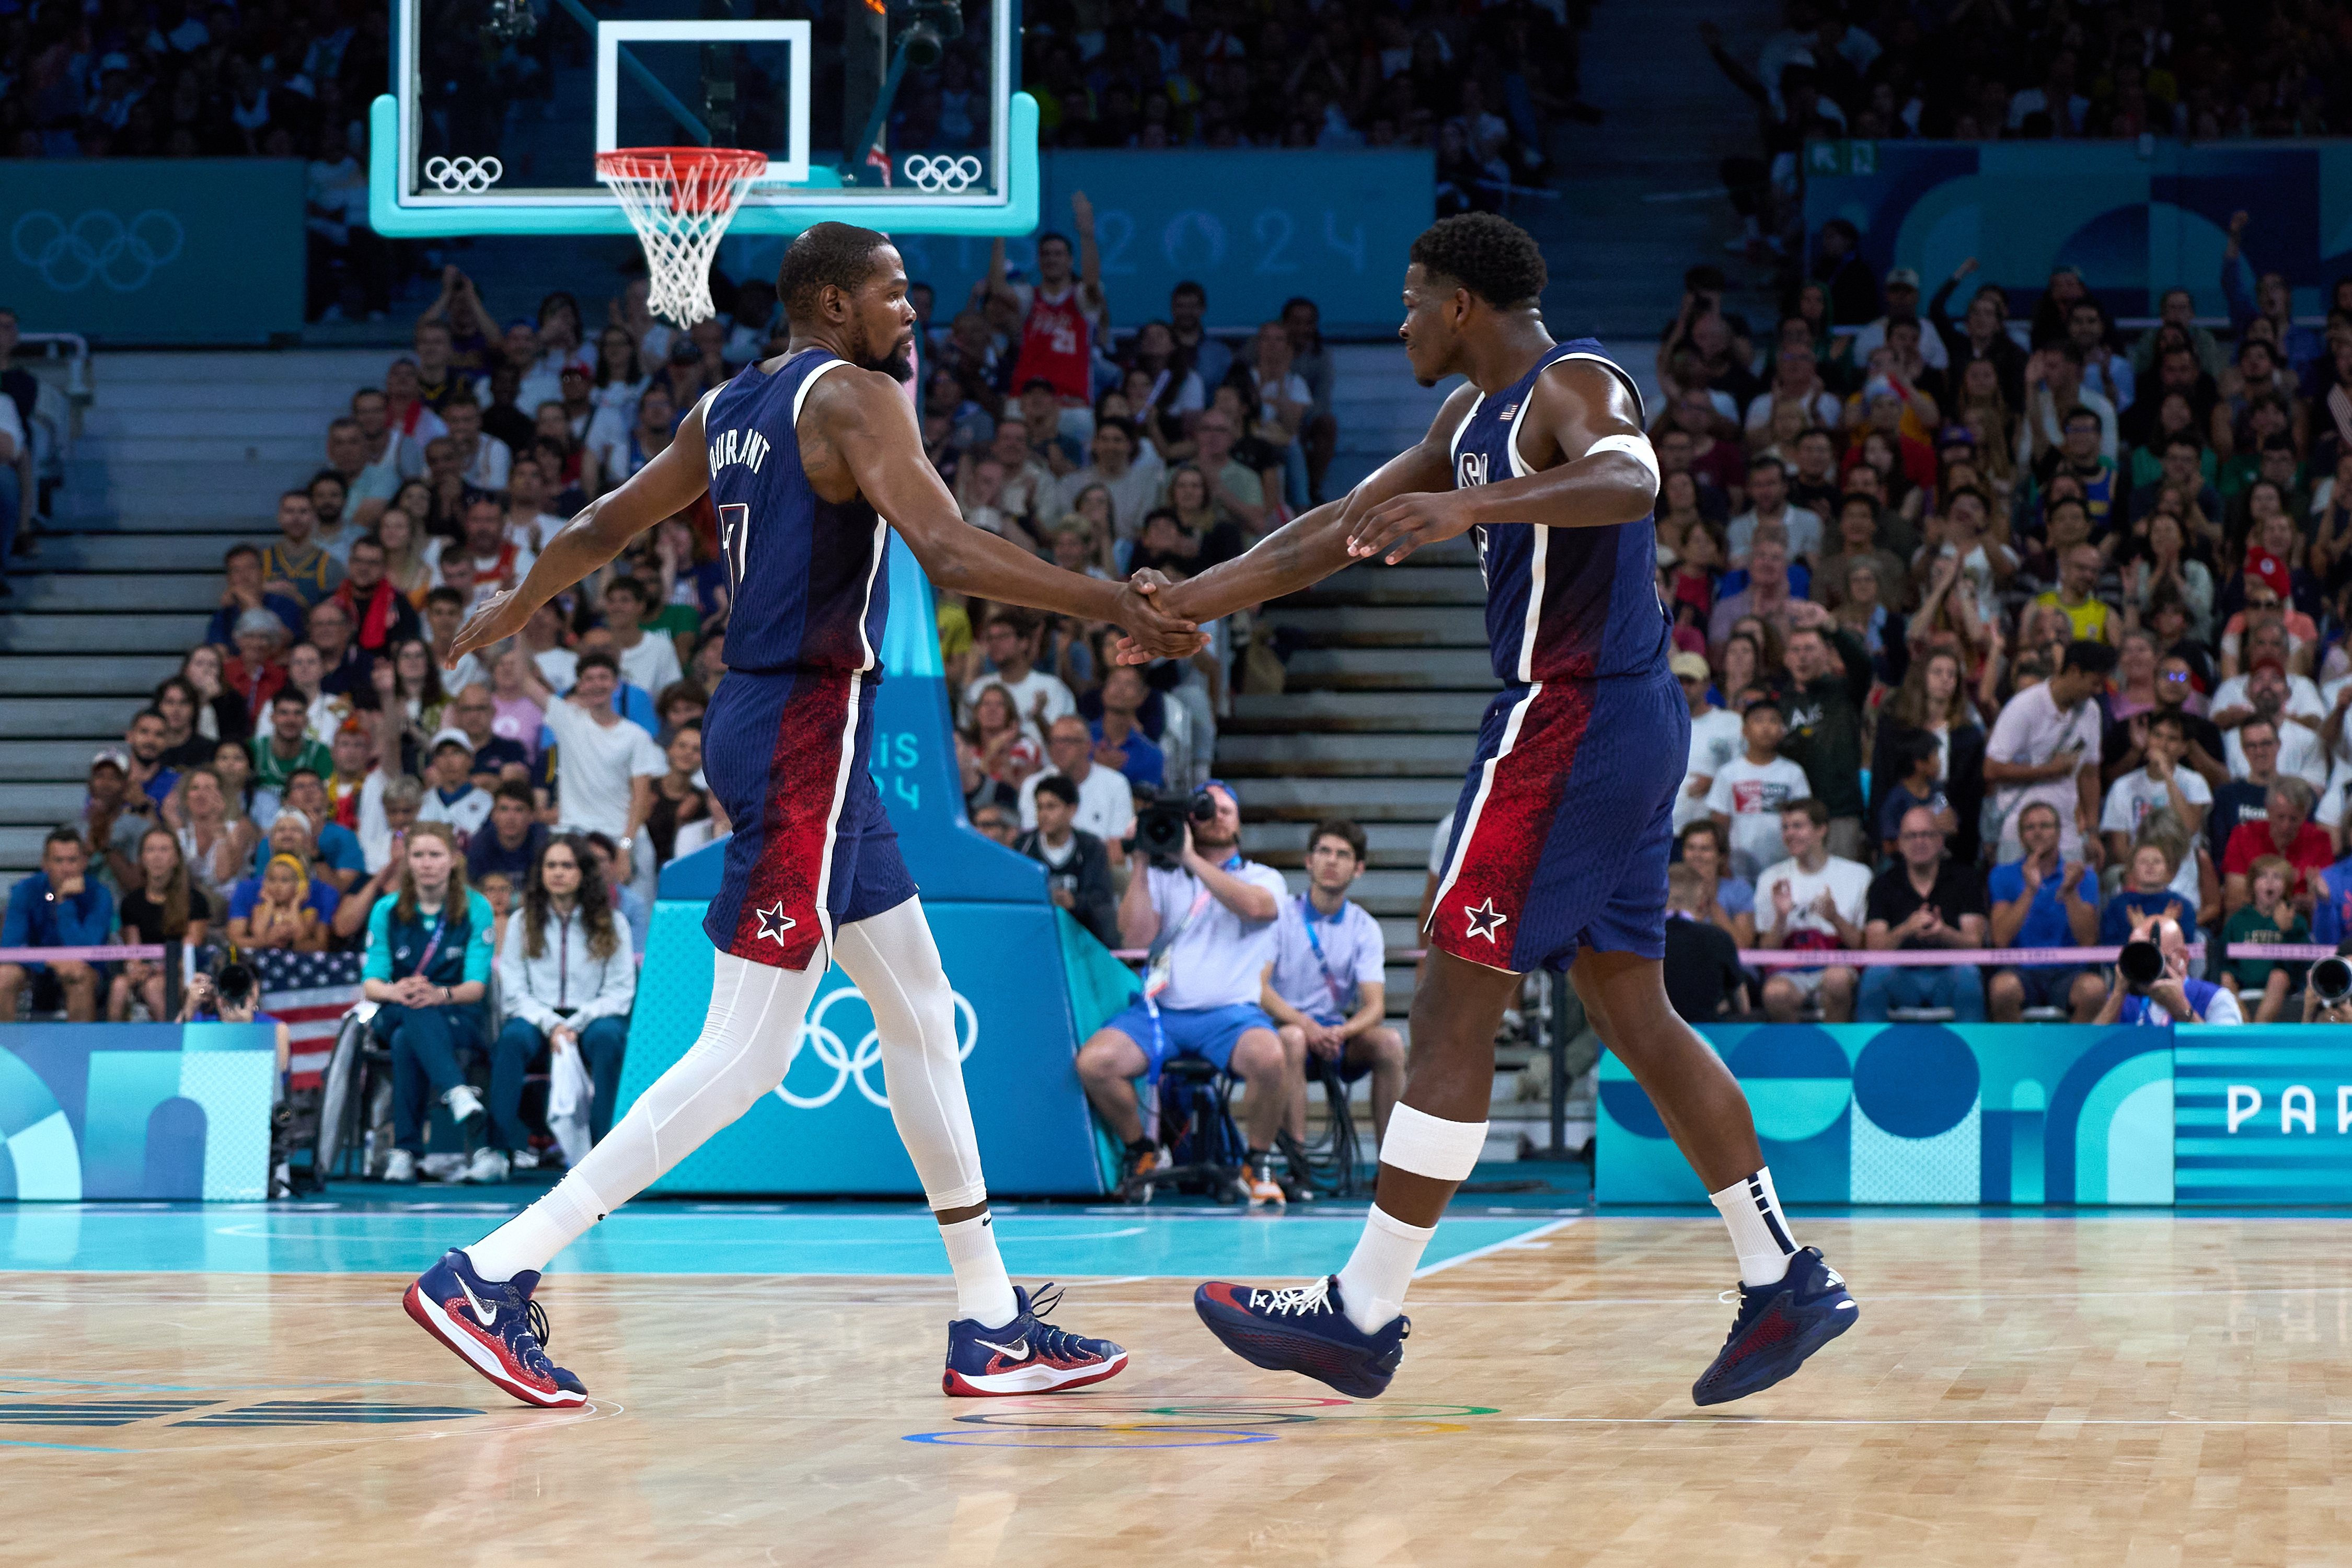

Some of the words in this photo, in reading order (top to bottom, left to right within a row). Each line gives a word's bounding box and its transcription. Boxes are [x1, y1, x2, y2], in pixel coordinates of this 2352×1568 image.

[1095, 209, 1366, 274] 2024
[709, 428, 771, 481] DURANT
[1457, 453, 1488, 489] SA
[719, 503, 750, 614] 7
